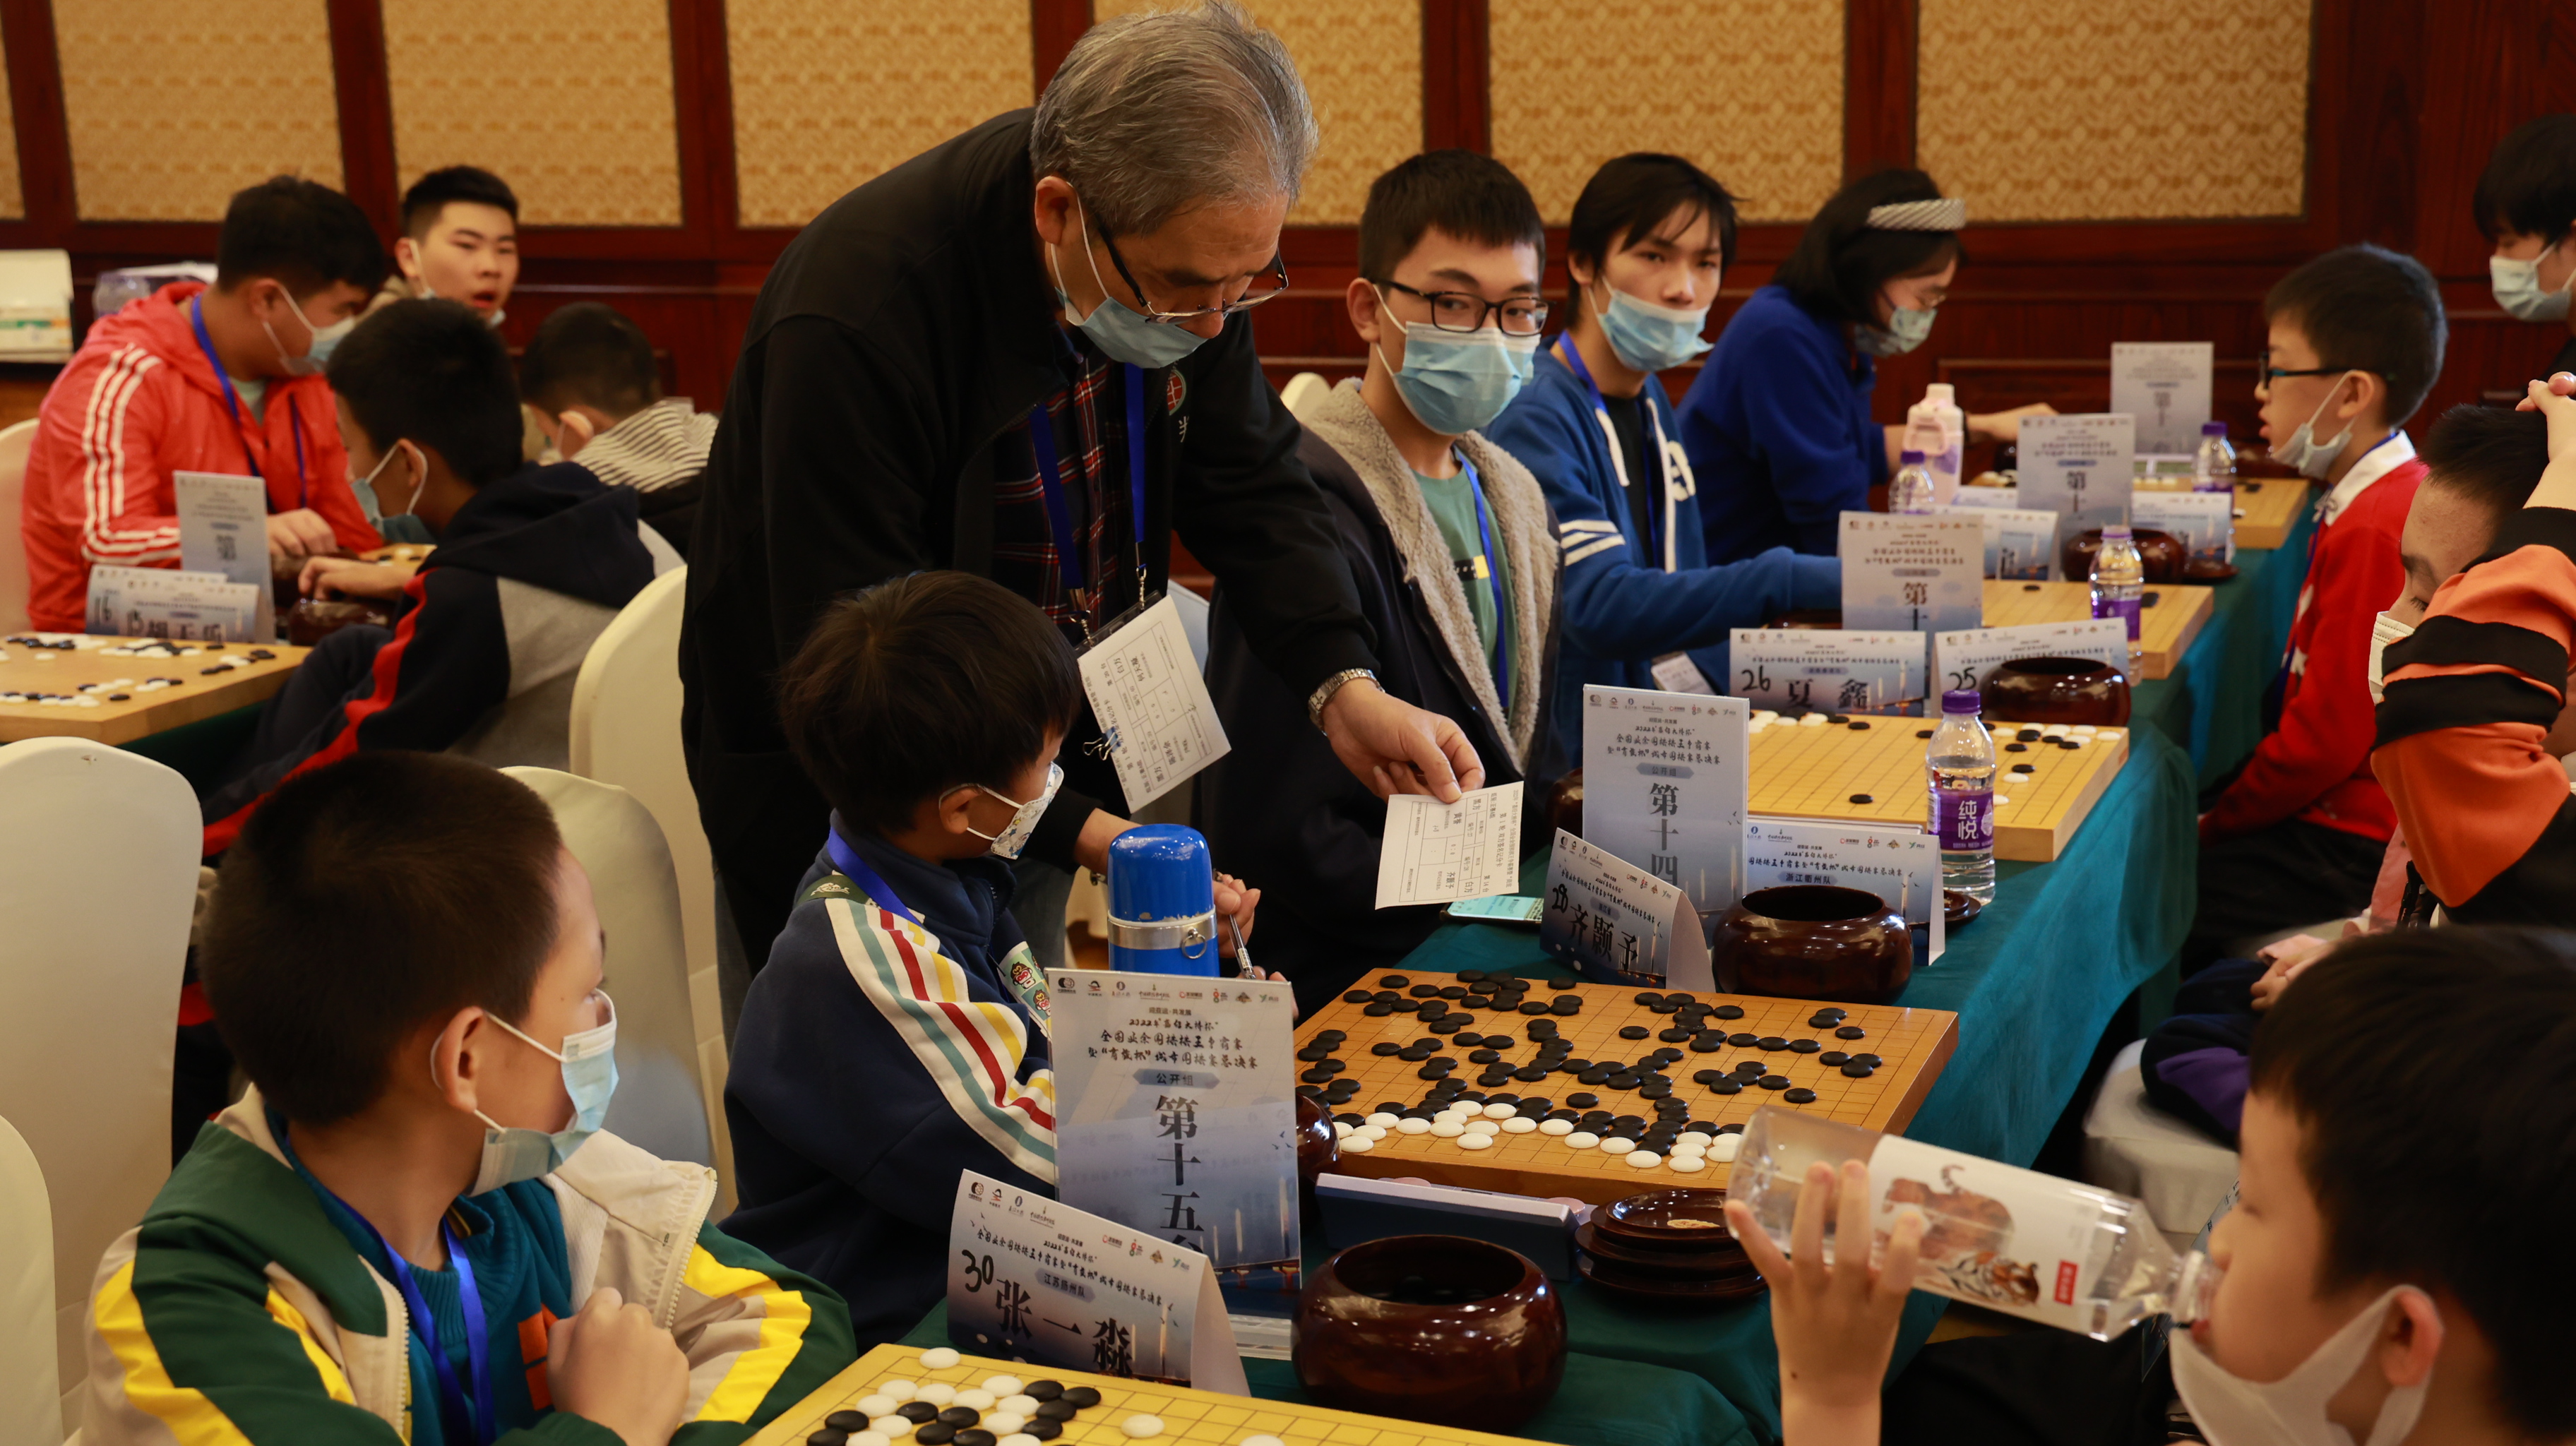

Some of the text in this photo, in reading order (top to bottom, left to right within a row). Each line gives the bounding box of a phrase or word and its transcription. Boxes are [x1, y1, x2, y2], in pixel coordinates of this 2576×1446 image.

[1741, 665, 1771, 693] 26
[1948, 667, 1977, 691] 25
[1785, 678, 1869, 710] 夏鑫
[1651, 766, 1677, 777] 公开组
[1958, 800, 1977, 840] 纯悦
[1463, 881, 1474, 893] 白方
[1785, 873, 1831, 885] 浙江衢州队
[1551, 883, 1568, 914] 28
[1156, 1072, 1194, 1087] 公开组
[962, 1248, 995, 1293] 30
[1044, 1273, 1086, 1299] 江苏扬州队
